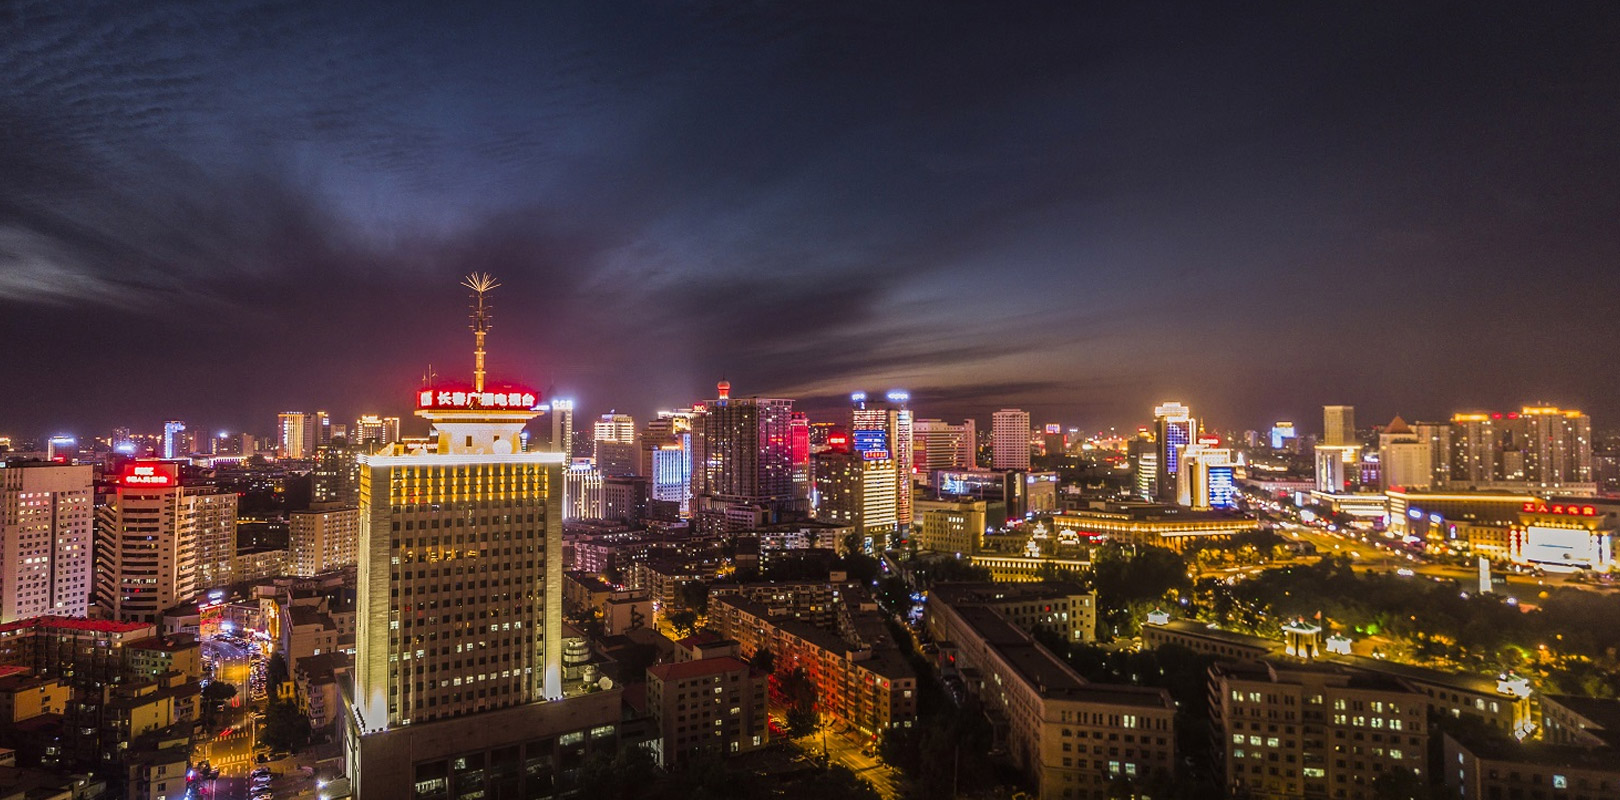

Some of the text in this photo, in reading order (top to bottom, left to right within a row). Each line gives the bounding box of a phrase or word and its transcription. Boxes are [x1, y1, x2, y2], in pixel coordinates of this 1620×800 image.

[437, 391, 535, 406] 长春广播电视台
[1523, 502, 1596, 516] 工人文化宫
